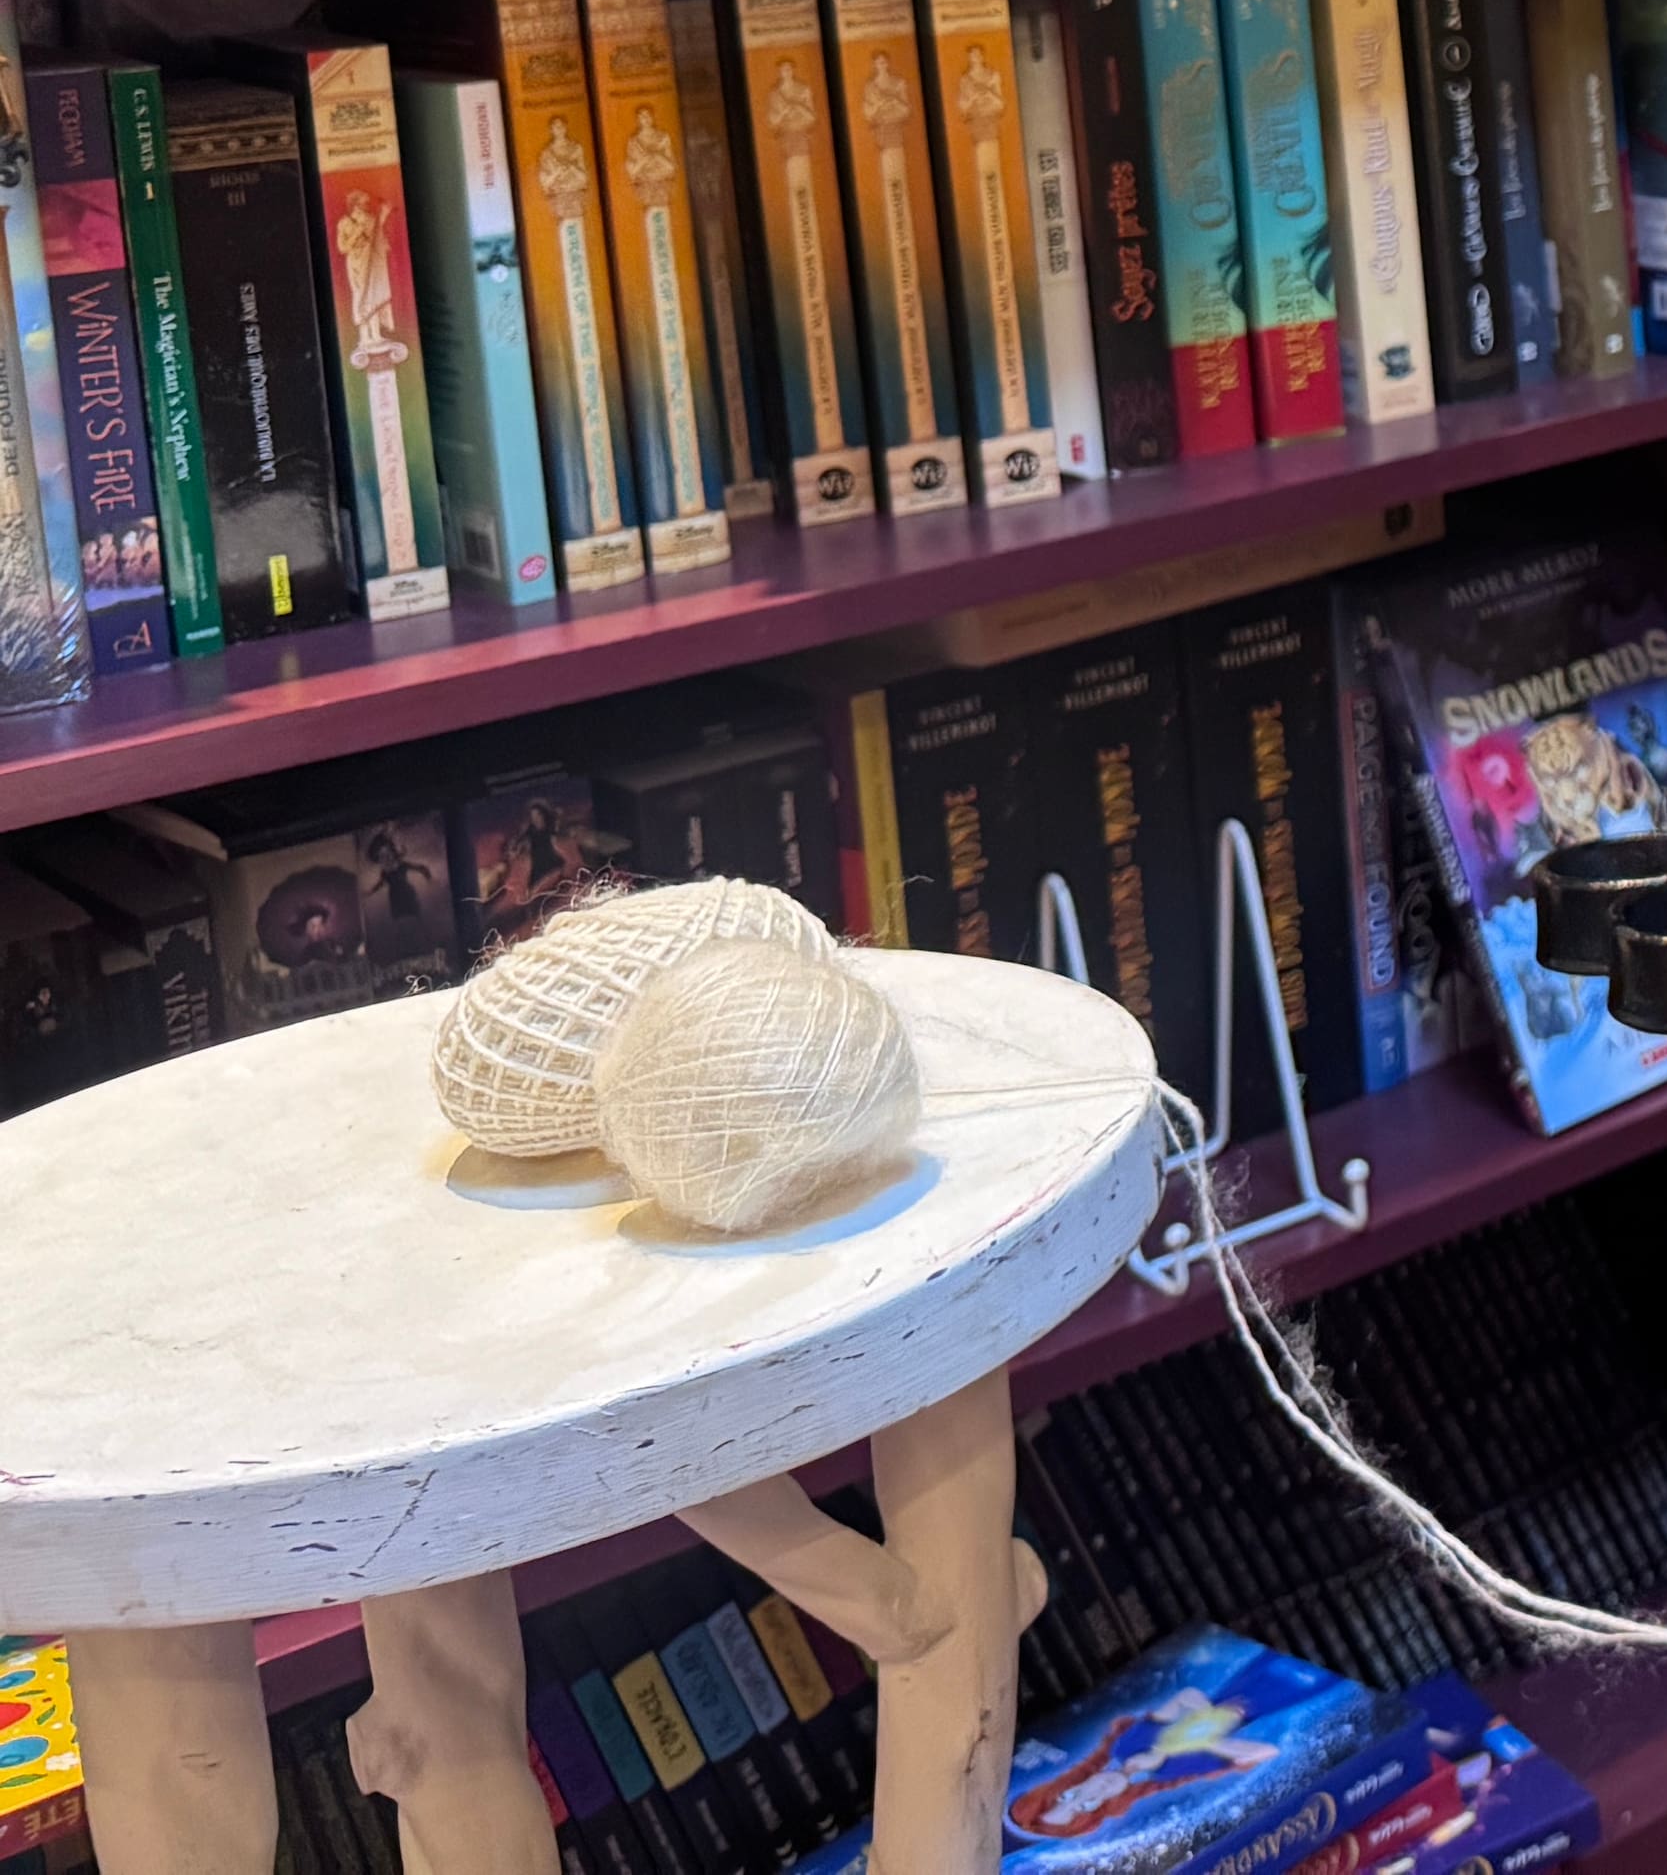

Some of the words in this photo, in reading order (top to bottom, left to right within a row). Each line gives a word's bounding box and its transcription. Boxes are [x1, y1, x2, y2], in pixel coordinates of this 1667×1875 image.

[137, 120, 156, 172] LEWIS
[1108, 159, 1150, 238] prêtes
[153, 270, 173, 319] The
[1112, 243, 1154, 323] Soyez
[66, 282, 125, 441] WINTER'S
[155, 320, 184, 423] Magician's
[88, 446, 136, 514] FIRE
[163, 424, 192, 483] Nephew
[1353, 694, 1383, 806] PAIGE
[1364, 864, 1396, 988] FOUND
